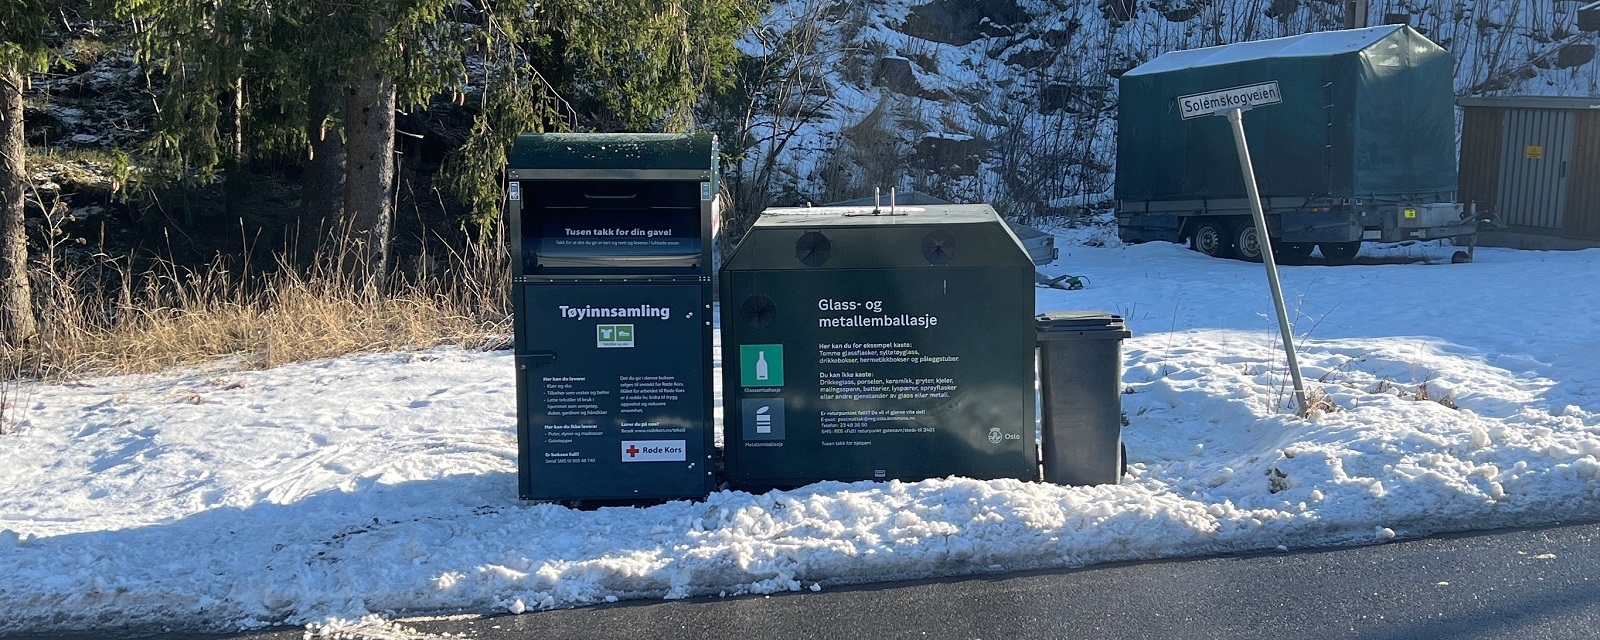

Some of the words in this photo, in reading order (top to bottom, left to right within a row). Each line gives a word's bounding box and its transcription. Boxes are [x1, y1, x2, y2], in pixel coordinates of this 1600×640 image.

[1185, 88, 1276, 112] Solemskogveien
[647, 228, 672, 238] gave!
[559, 304, 670, 320] Tøyinnsamling
[818, 299, 861, 310] Glass-
[865, 300, 882, 313] og
[819, 314, 938, 328] metallemballasje
